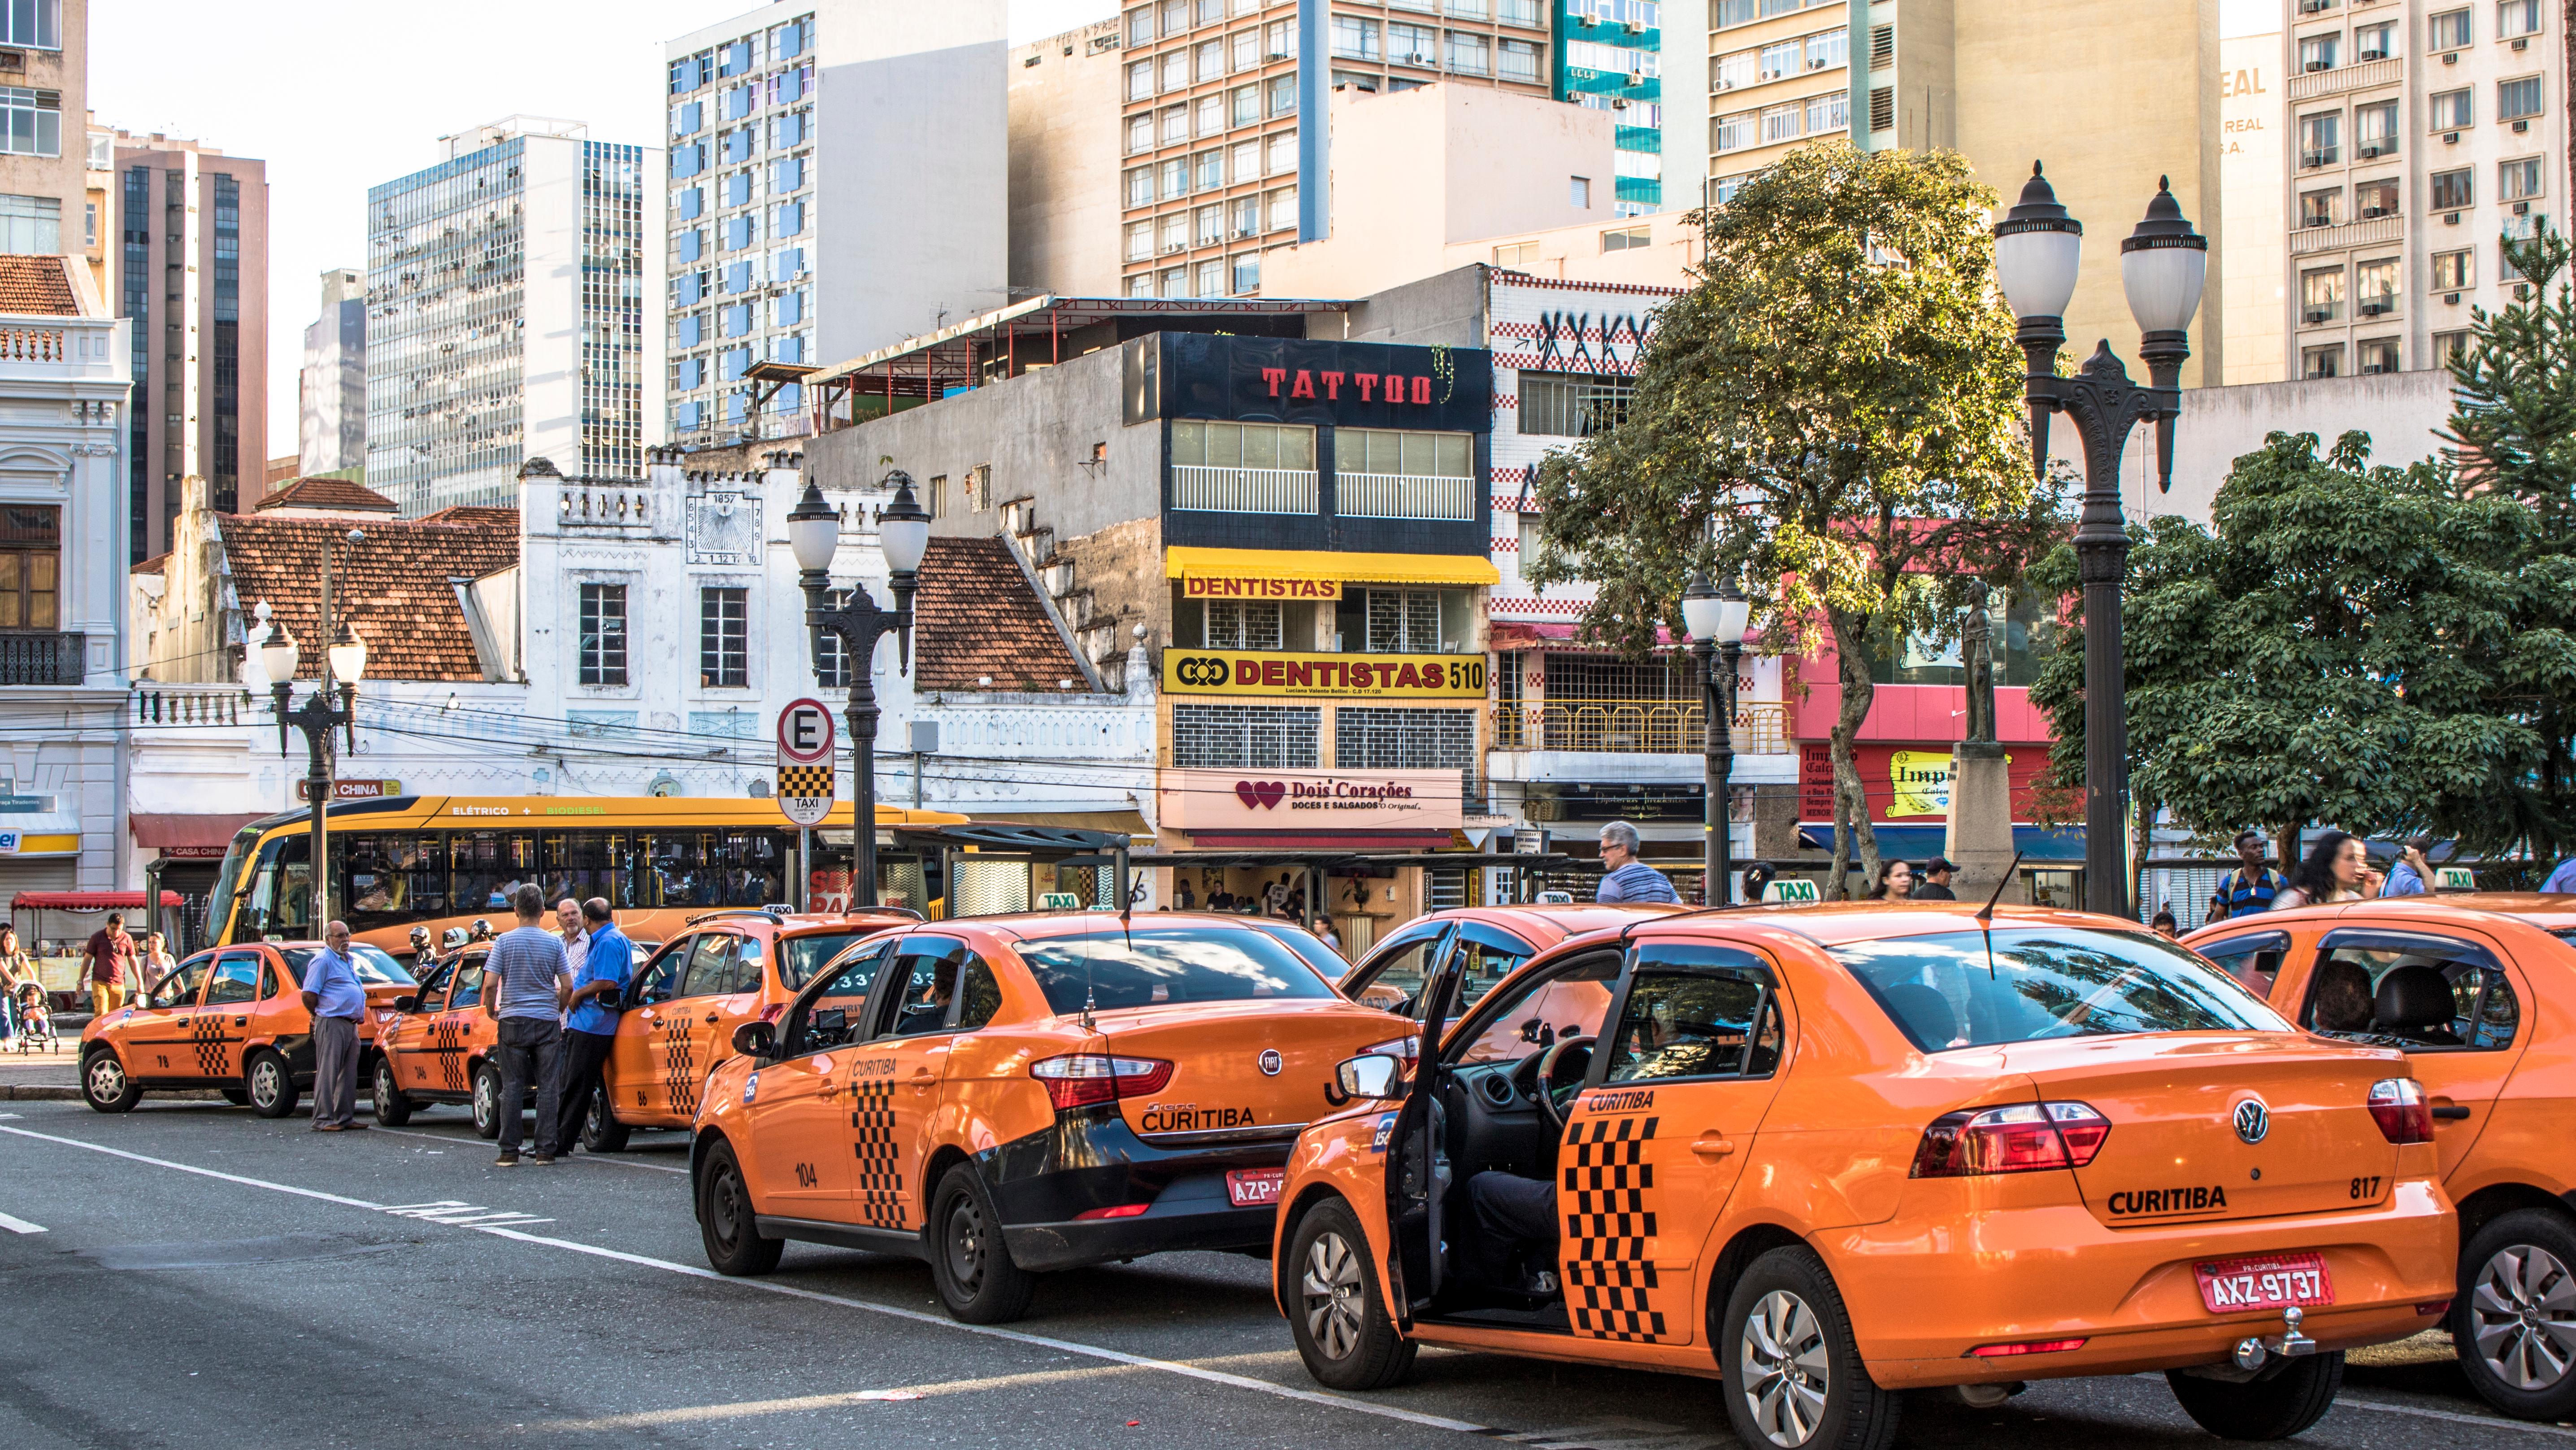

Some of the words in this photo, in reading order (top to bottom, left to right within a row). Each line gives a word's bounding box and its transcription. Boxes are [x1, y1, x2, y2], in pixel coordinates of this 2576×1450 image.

[2225, 118, 2263, 133] REAL
[1262, 367, 1432, 404] TATTOO
[713, 494, 736, 504] 1857
[688, 503, 694, 512] 6
[688, 514, 694, 522] 5
[755, 519, 760, 527] 8
[688, 525, 694, 534] 4
[755, 532, 760, 540] 9
[688, 540, 694, 549] 3
[718, 555, 728, 563] 12
[1189, 578, 1335, 597] DENTISTAS
[1235, 660, 1445, 688] DENTISTAS
[1450, 662, 1483, 690] 510
[794, 710, 817, 749] E
[340, 784, 378, 795] CHINA
[1292, 782, 1330, 798] Dois
[1336, 781, 1412, 802] Corações
[794, 798, 818, 808] TAXI
[1807, 798, 1831, 807] Sempre
[453, 805, 509, 815] ELÉTRICO
[547, 806, 606, 815] BIODIESEL
[1806, 809, 1831, 817] MENOR
[176, 848, 199, 856] CASA
[2444, 871, 2473, 887] TAXI
[1774, 882, 1815, 901] TAXI
[1044, 895, 1075, 908] TAXI
[767, 906, 791, 914] TAXI
[672, 1006, 691, 1016] CURITIBA
[157, 1055, 169, 1068] 78
[853, 1058, 896, 1077] CURITIBA
[1264, 1057, 1278, 1069] FIAT
[745, 1085, 755, 1097] 156
[637, 1091, 647, 1107] 86
[1588, 1090, 1654, 1112] CURITIBA
[1143, 1102, 1196, 1112] Siena
[1142, 1107, 1255, 1131] CURITIBA
[795, 1163, 817, 1188] 104
[2350, 1176, 2381, 1199] 817
[2107, 1185, 2227, 1215] CURITIBA
